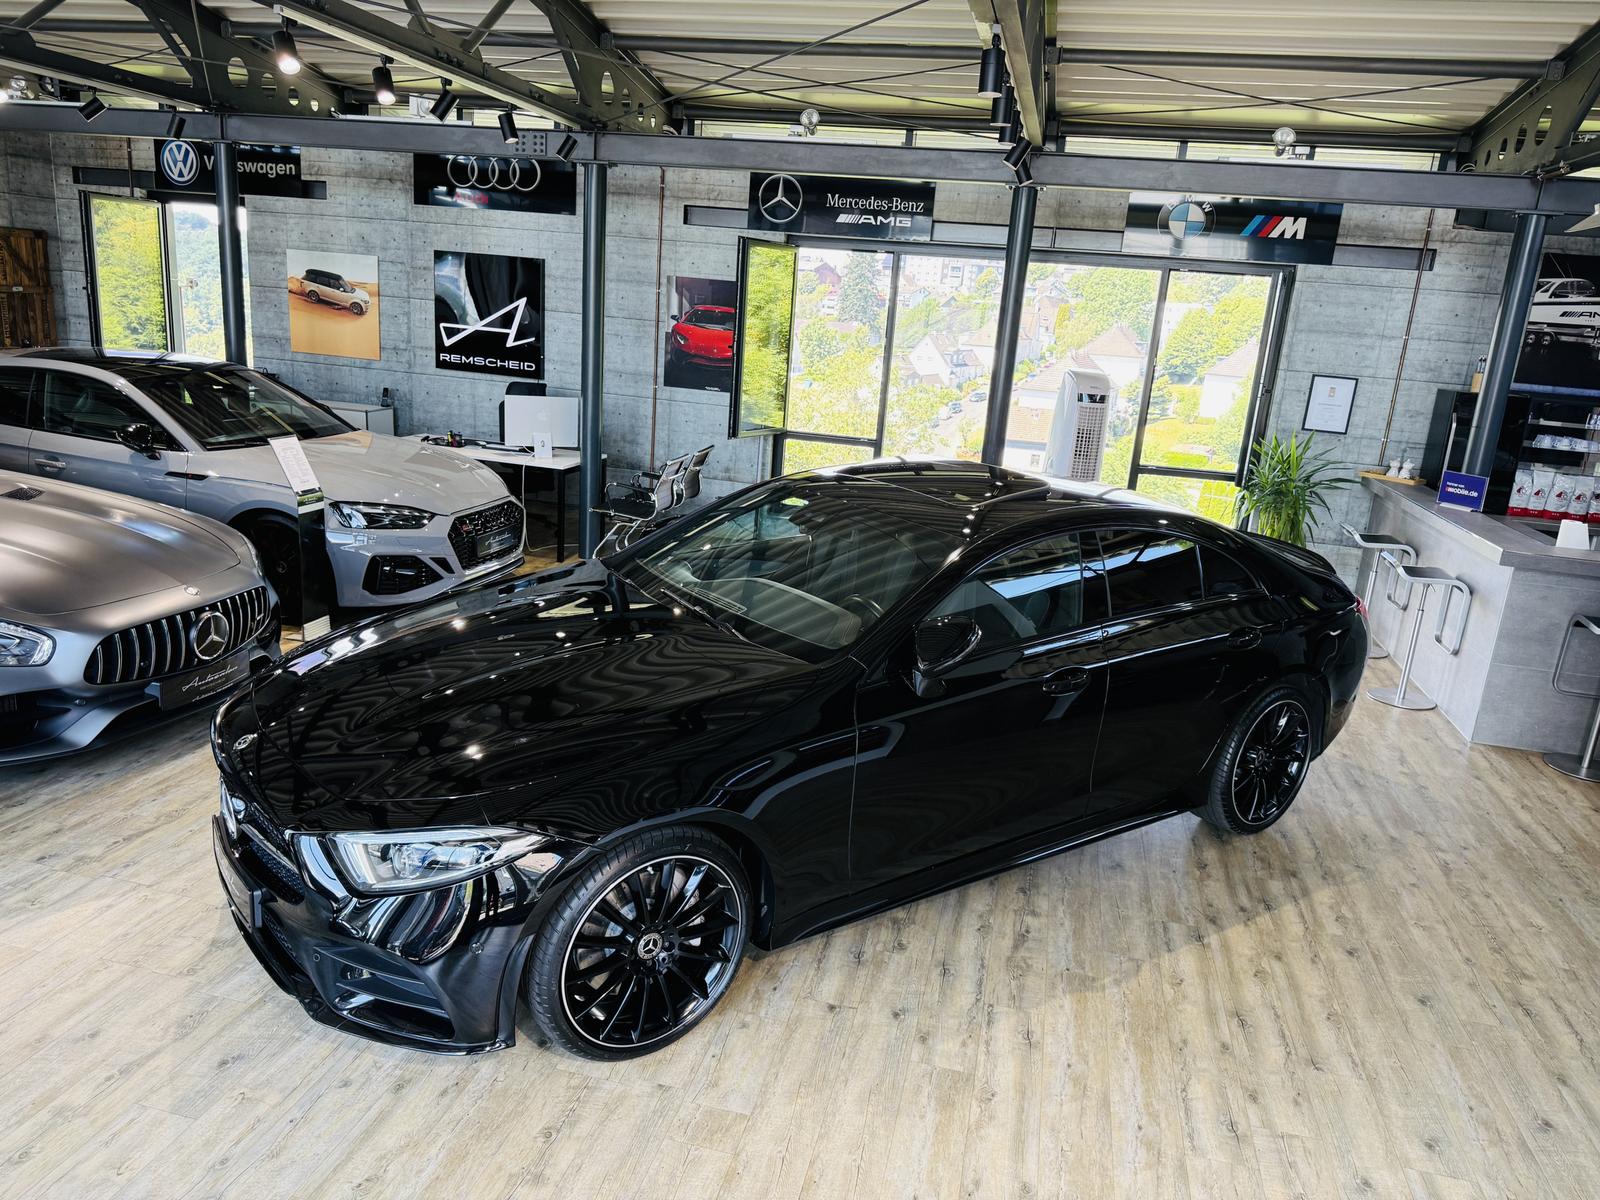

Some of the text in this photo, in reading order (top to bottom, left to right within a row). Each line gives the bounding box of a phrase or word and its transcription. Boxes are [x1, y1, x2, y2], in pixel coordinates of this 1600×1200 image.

[203, 154, 296, 179] Vswagen
[826, 193, 924, 213] Mercedes-Benz
[857, 213, 912, 227] AMG
[439, 353, 536, 371] REMSCHEID
